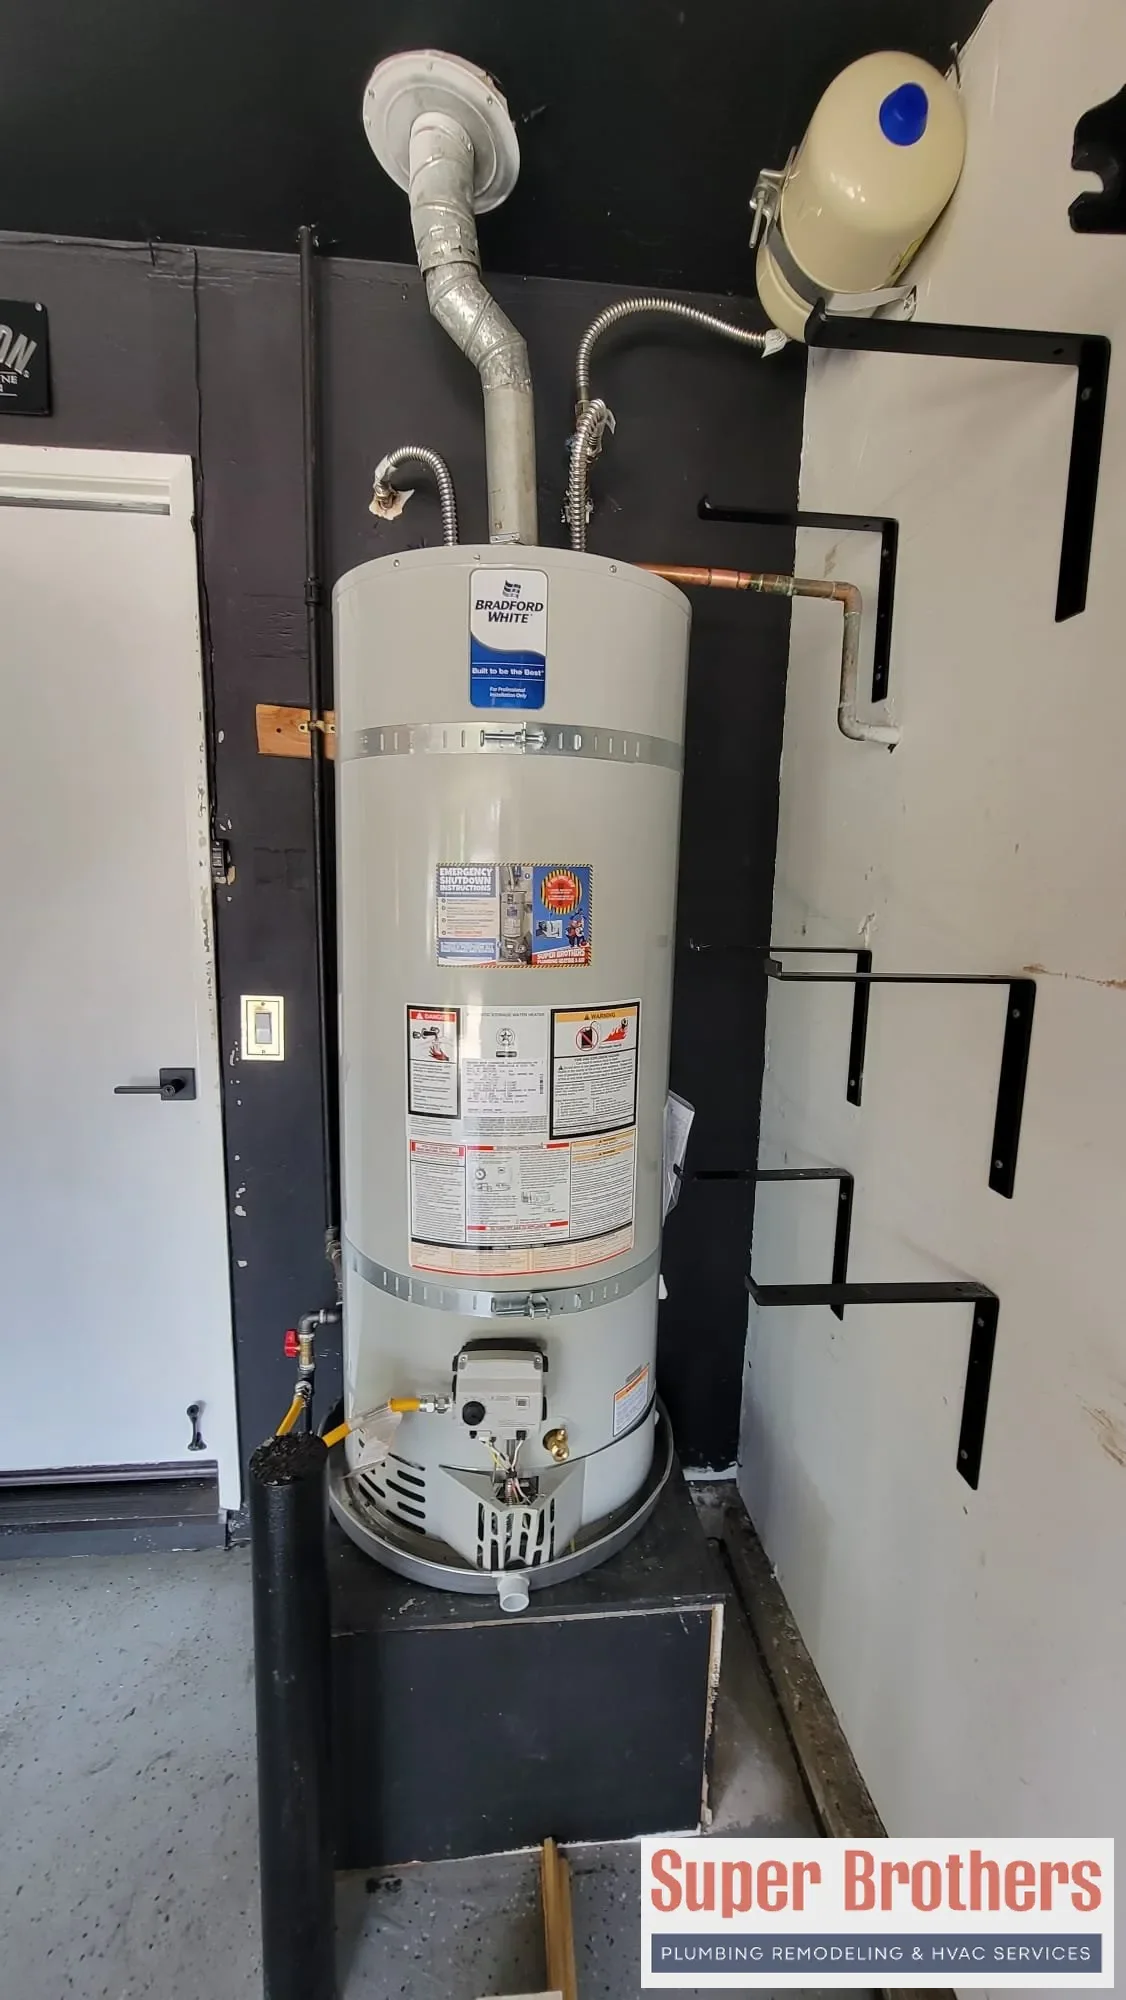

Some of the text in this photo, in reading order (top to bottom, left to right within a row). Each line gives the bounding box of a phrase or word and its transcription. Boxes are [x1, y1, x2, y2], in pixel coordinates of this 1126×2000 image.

[475, 598, 544, 612] BRADFORD
[488, 611, 530, 623] WHITE
[439, 867, 493, 876] EMERGENCY
[439, 876, 492, 885] SHUTDOWN
[439, 884, 491, 892] INSTRUCTIONS
[591, 1012, 616, 1020] WARNING
